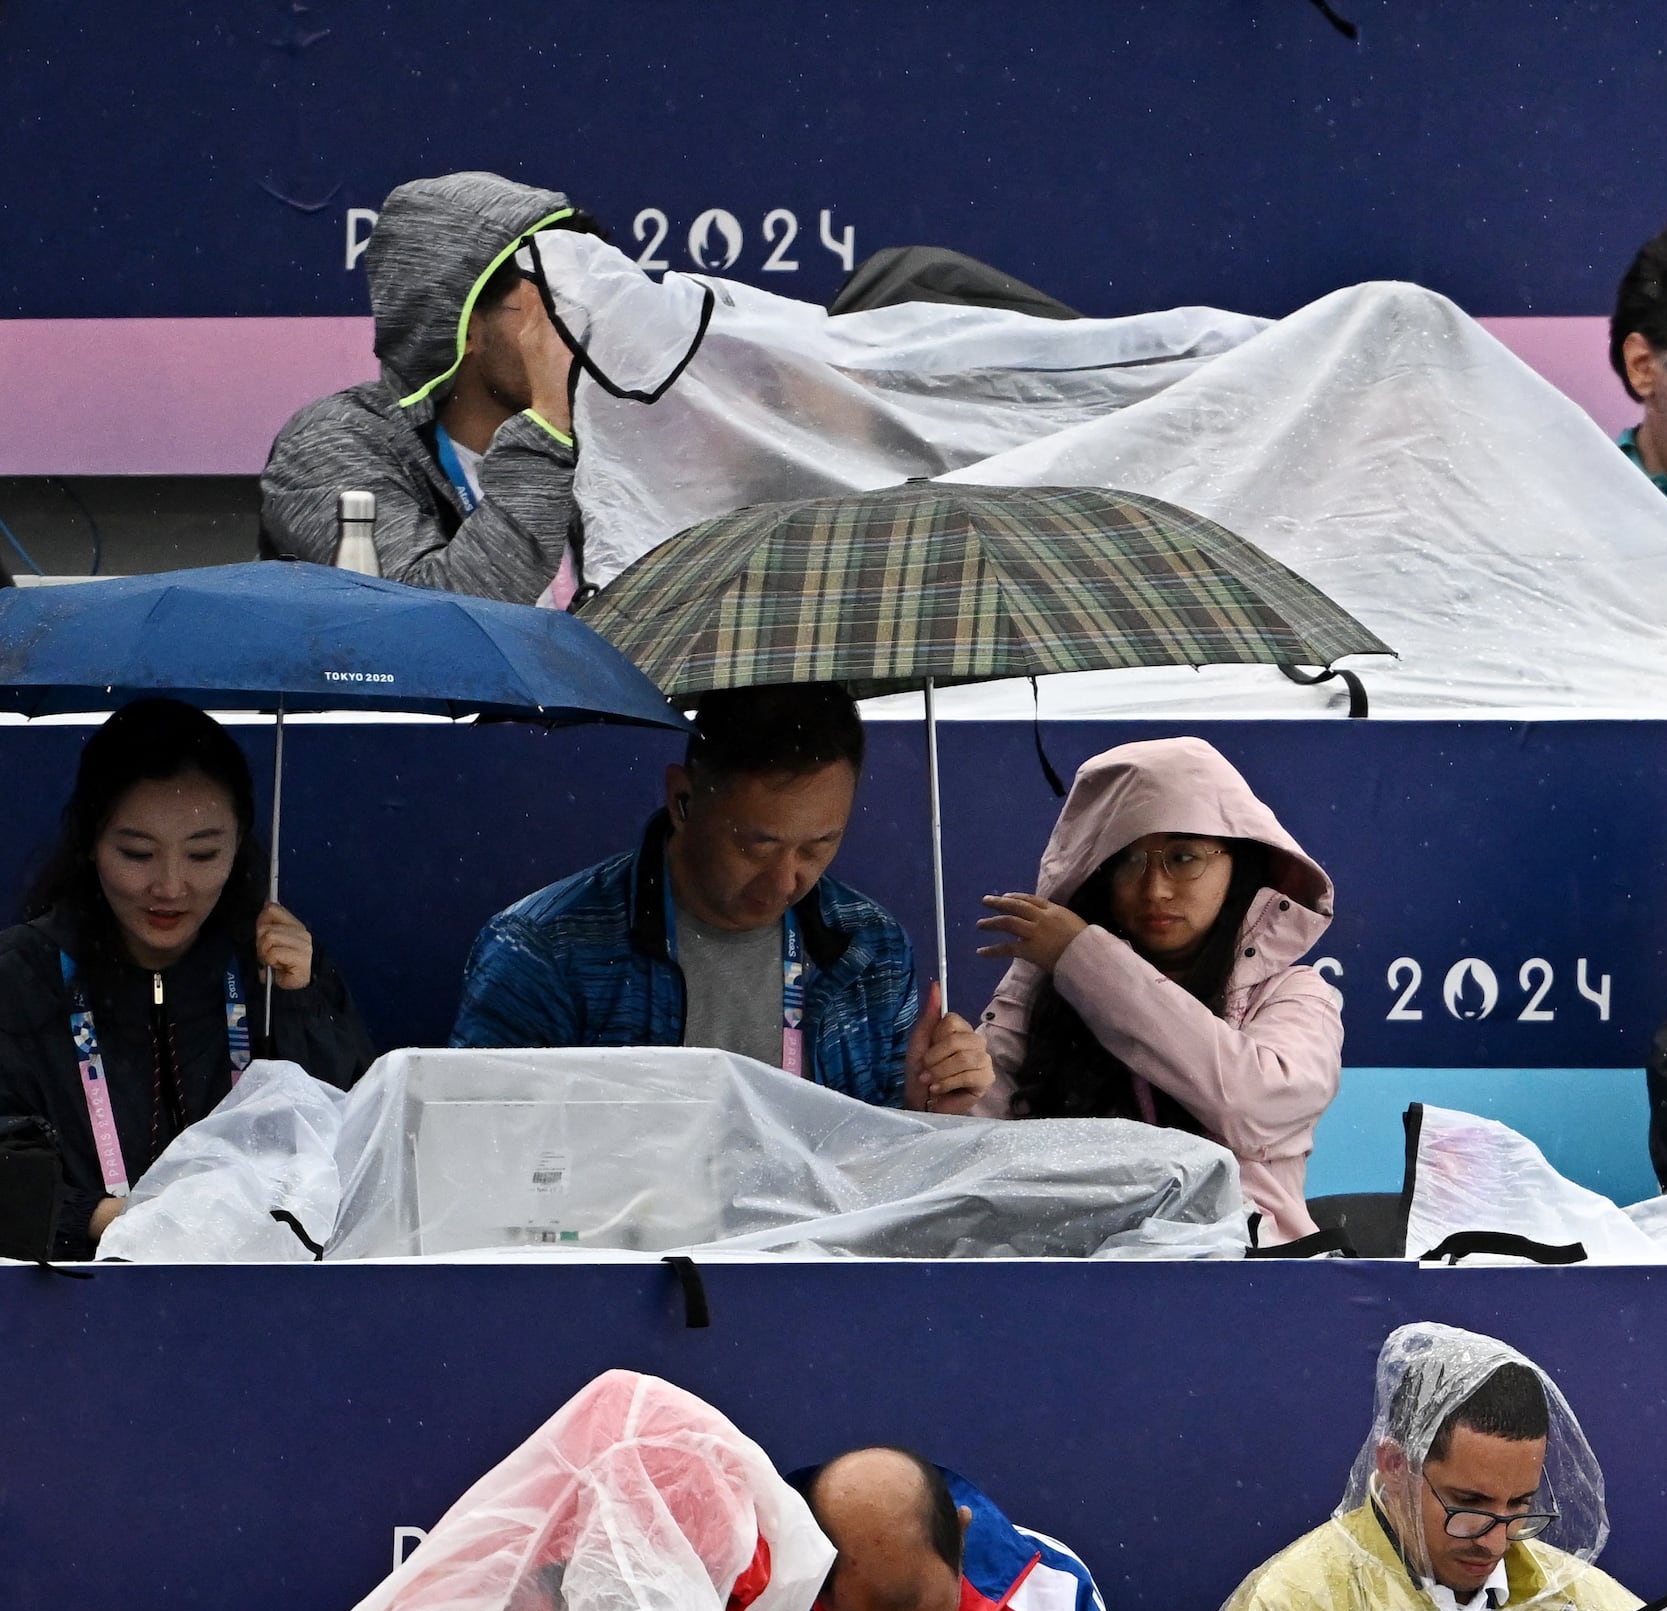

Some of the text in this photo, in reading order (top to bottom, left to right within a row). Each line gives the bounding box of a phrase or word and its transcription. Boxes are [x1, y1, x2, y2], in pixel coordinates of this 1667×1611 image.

[635, 208, 856, 272] 2024
[455, 486, 474, 512] Atos
[325, 671, 395, 682] TOKYO 2020
[788, 927, 798, 957] Atos
[226, 972, 239, 999] Atos
[1385, 947, 1610, 1021] 2024
